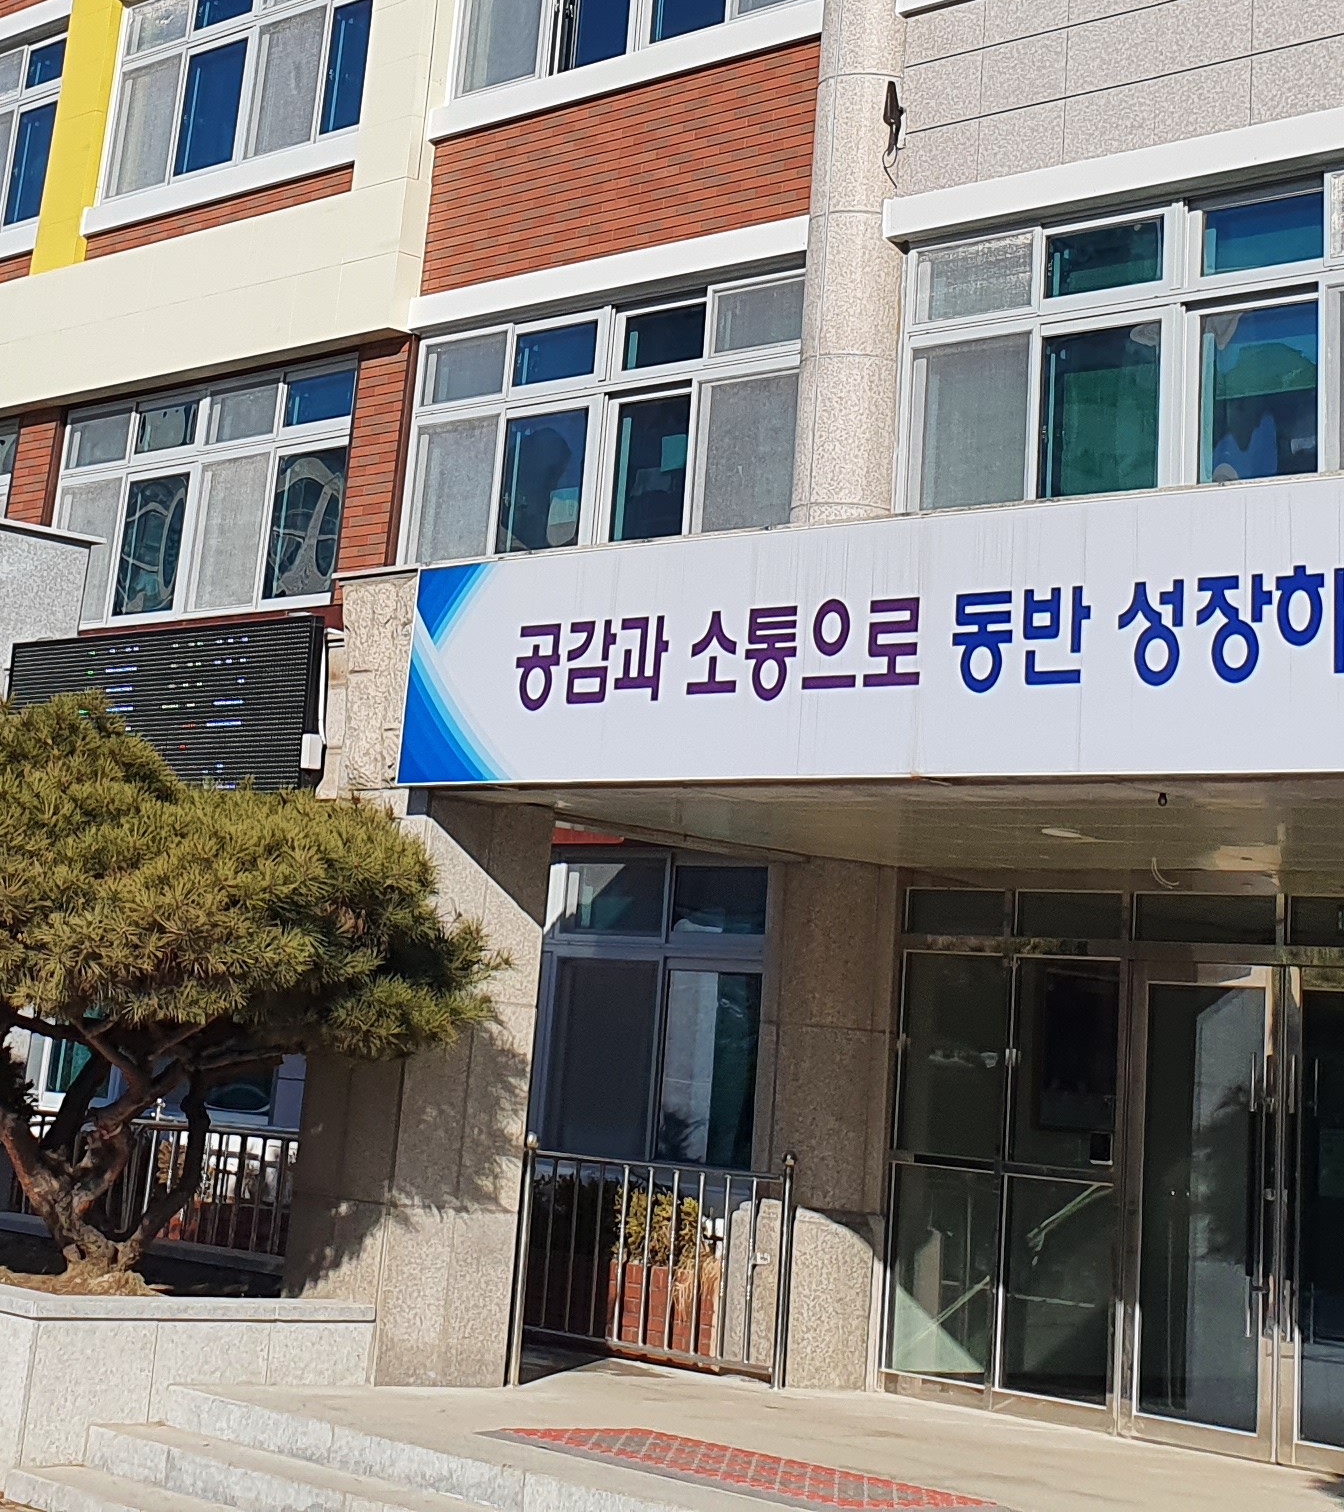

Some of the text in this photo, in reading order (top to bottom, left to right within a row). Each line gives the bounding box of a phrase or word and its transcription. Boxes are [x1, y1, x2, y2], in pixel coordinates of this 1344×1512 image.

[516, 616, 669, 712] 공감과
[687, 596, 921, 702] 소통으로
[952, 585, 1092, 694] 동반
